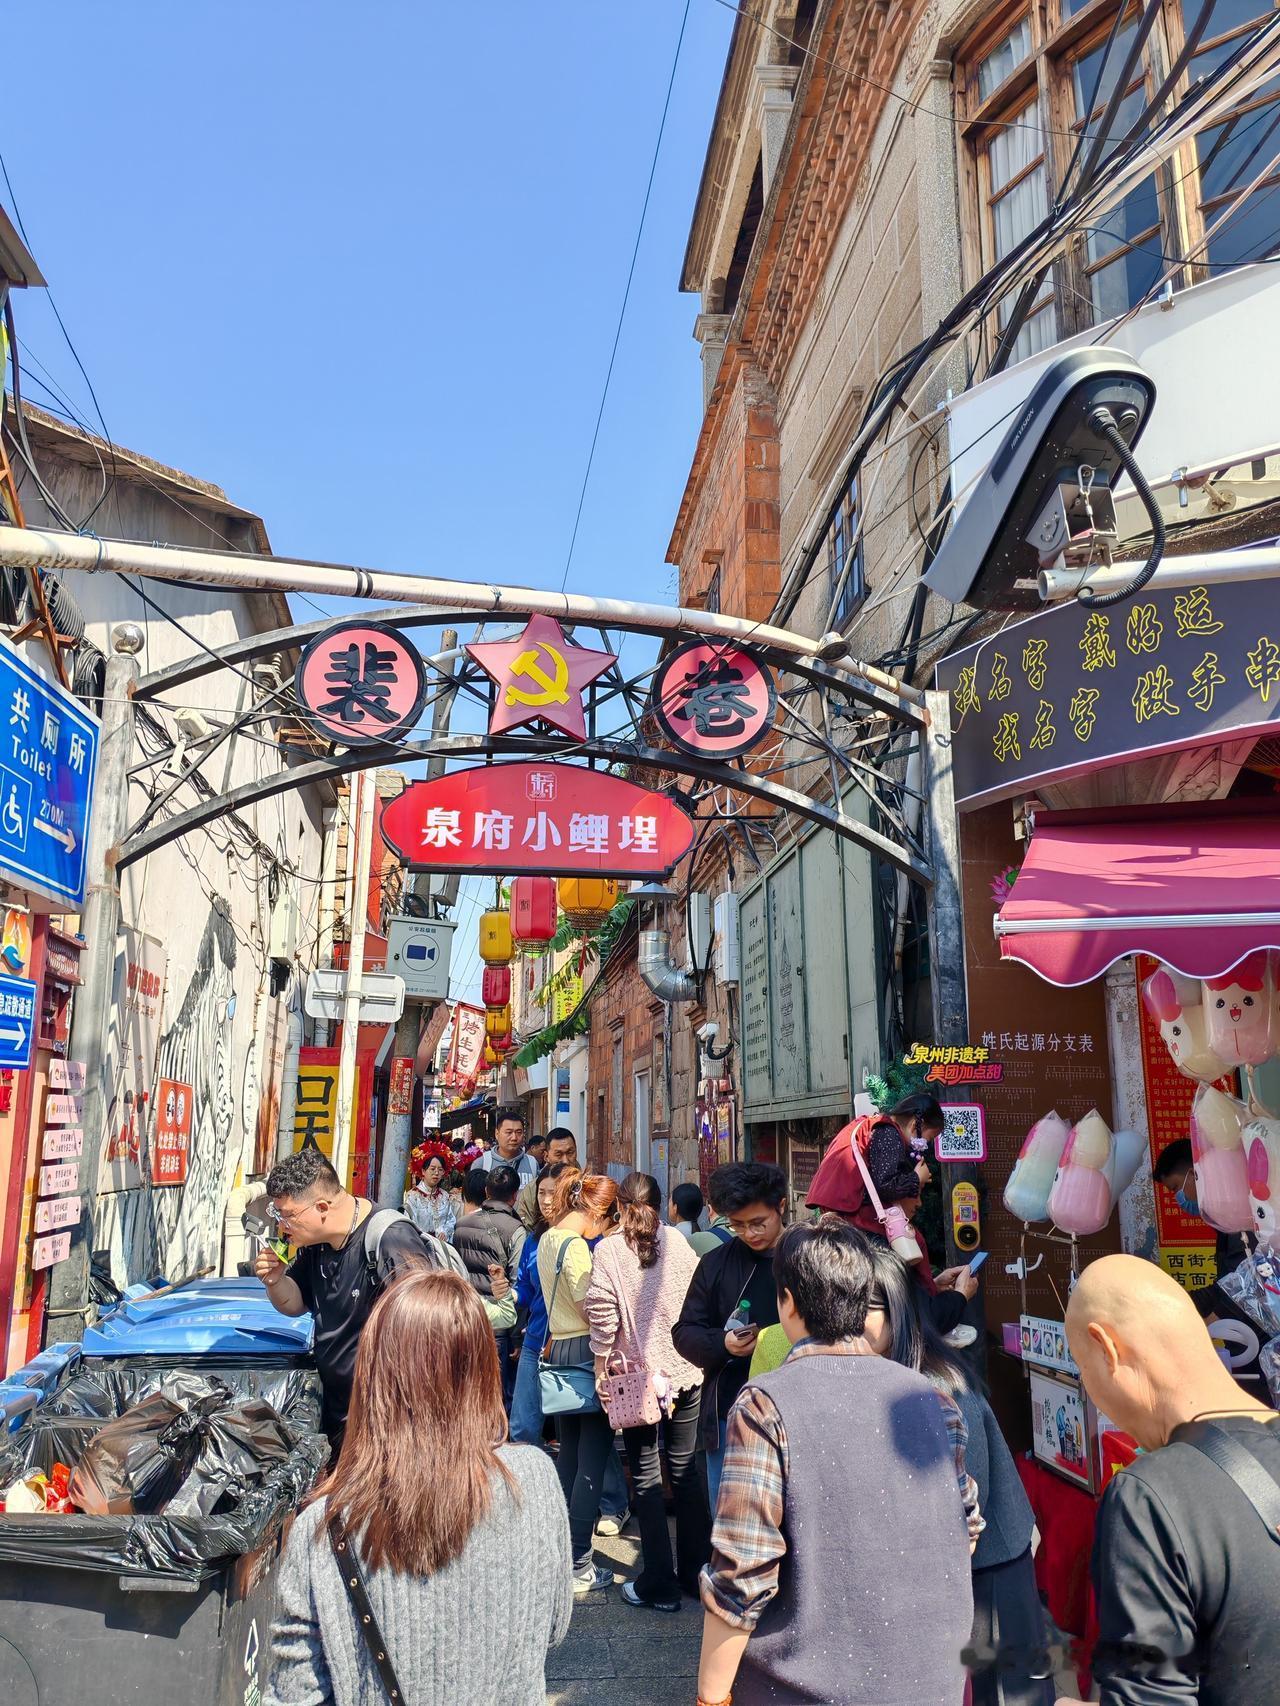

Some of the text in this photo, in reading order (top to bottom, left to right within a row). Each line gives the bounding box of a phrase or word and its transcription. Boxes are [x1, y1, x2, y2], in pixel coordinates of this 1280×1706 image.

[1079, 586, 1224, 672] 戴好运
[315, 641, 758, 738] 裴 巷
[1132, 637, 1280, 723] 做手串
[10, 687, 86, 776] 共厕所
[12, 735, 52, 782] Toilet
[40, 799, 64, 827] 270M
[421, 806, 659, 855] 泉府小鲤埕
[910, 1045, 989, 1064] 泉州非遗年
[981, 1031, 1093, 1052] 姓氏起源分支表
[927, 1064, 1003, 1084] 美团加点甜
